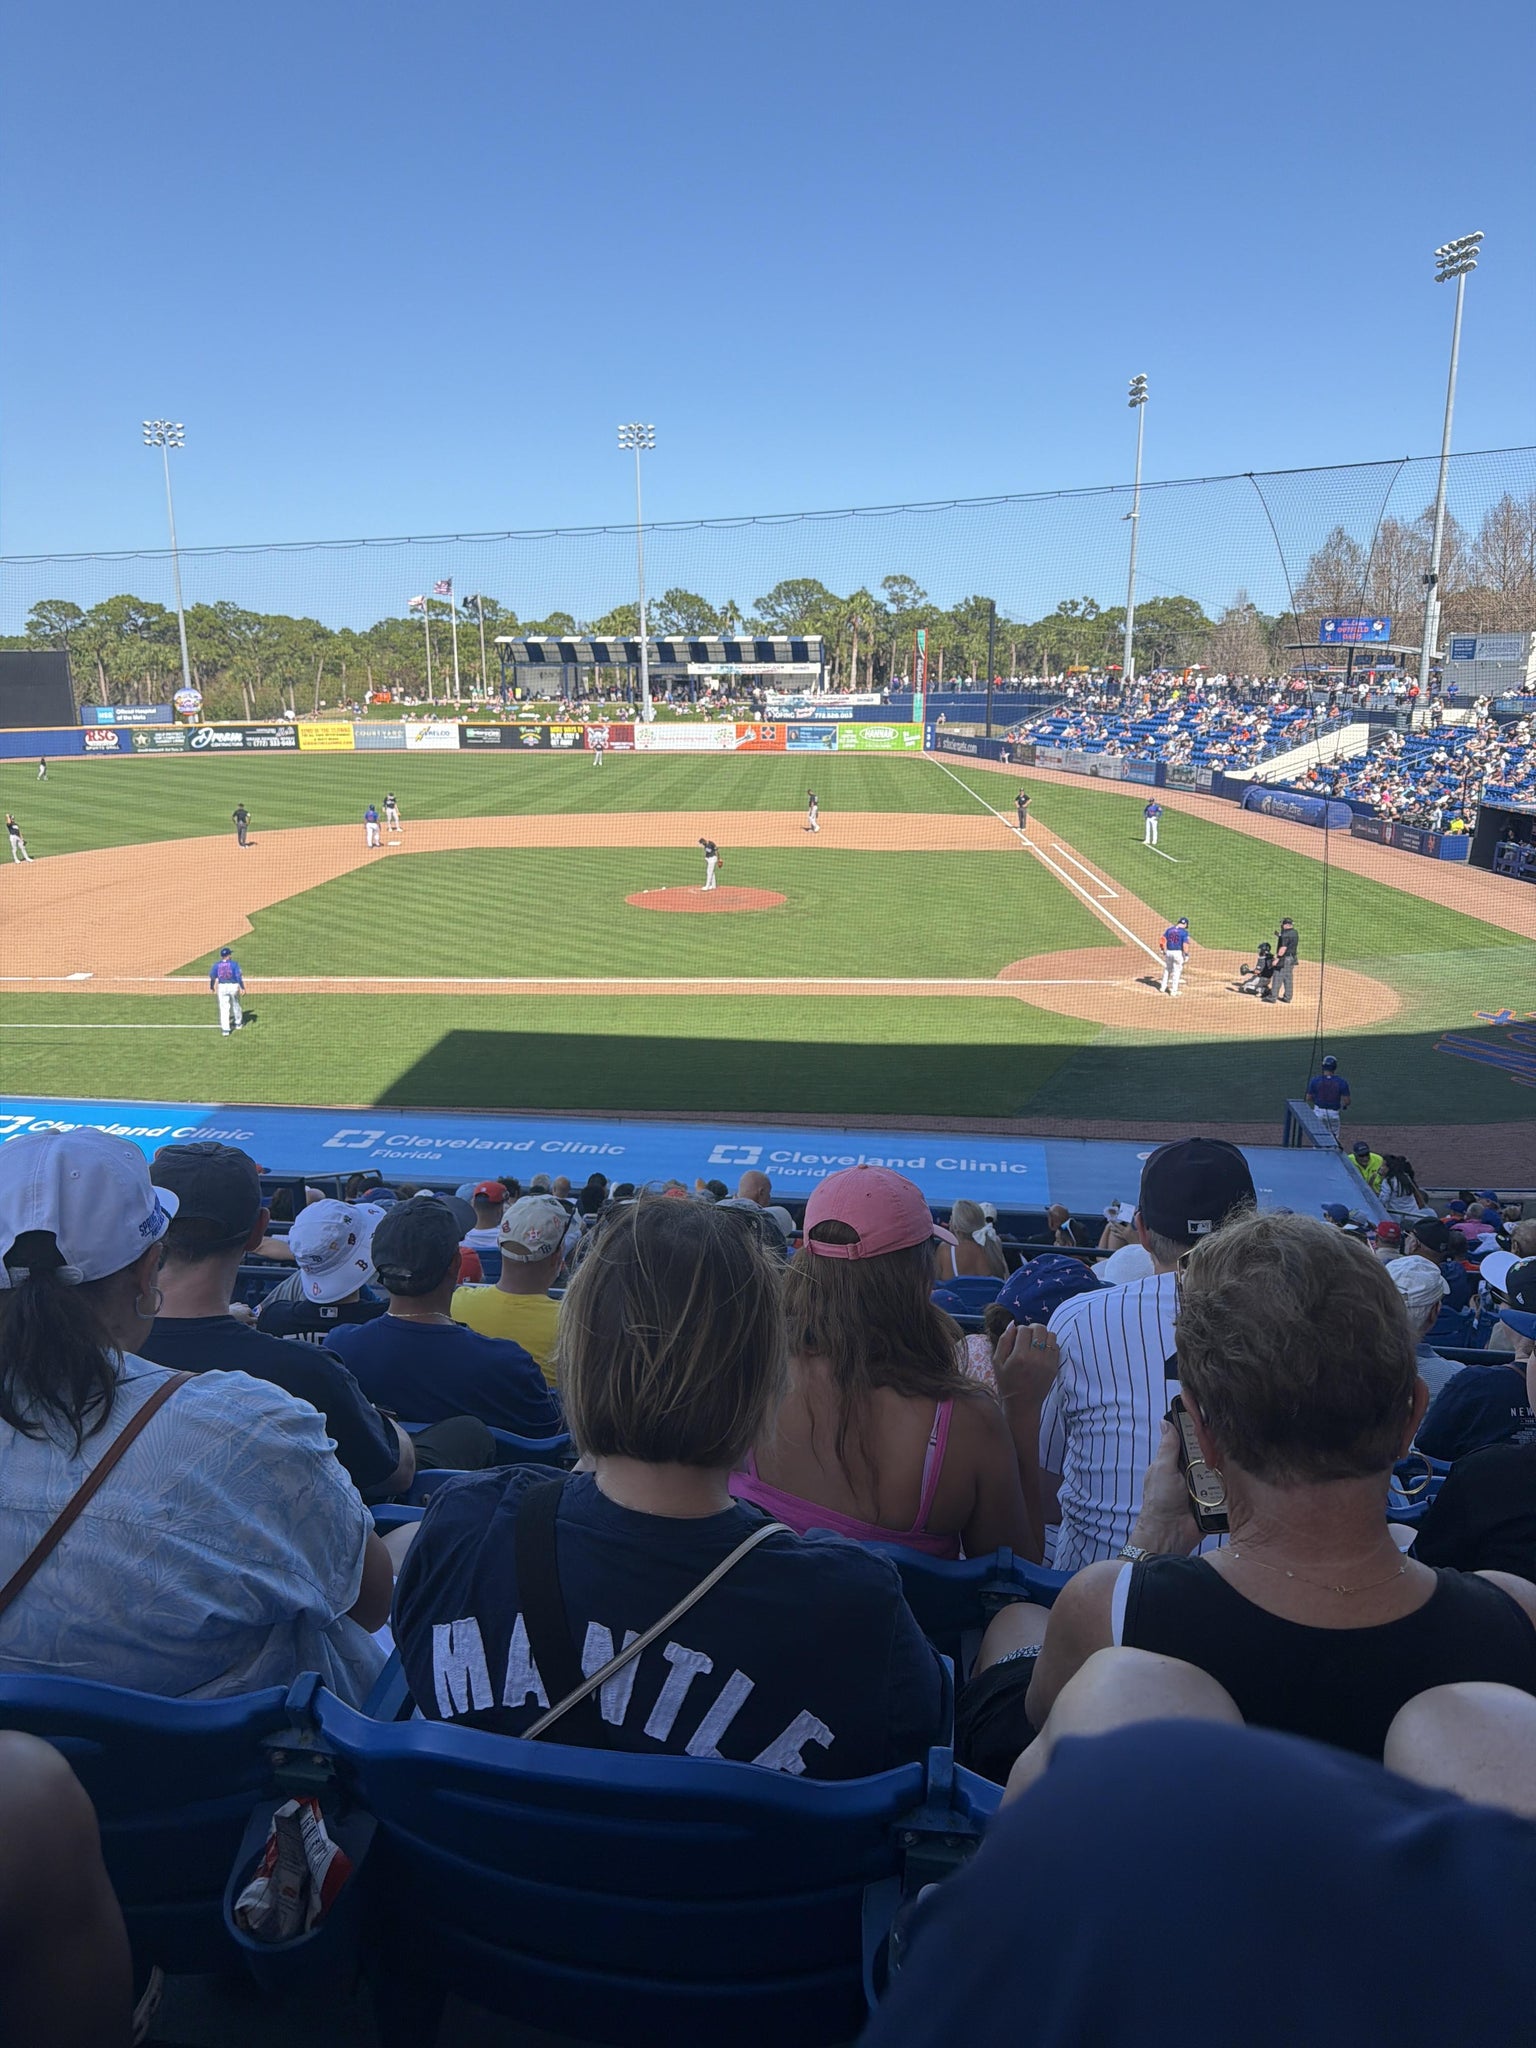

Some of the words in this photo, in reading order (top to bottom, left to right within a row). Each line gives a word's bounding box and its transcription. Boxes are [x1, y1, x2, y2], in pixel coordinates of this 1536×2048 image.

[87, 730, 115, 741] RSG
[171, 1126, 254, 1140] Clinic
[385, 1135, 536, 1152] Cleveland
[540, 1141, 626, 1155] Clinic
[370, 1149, 443, 1160] Florida
[769, 1150, 926, 1169] Cleveland
[935, 1158, 1028, 1174] Clinic
